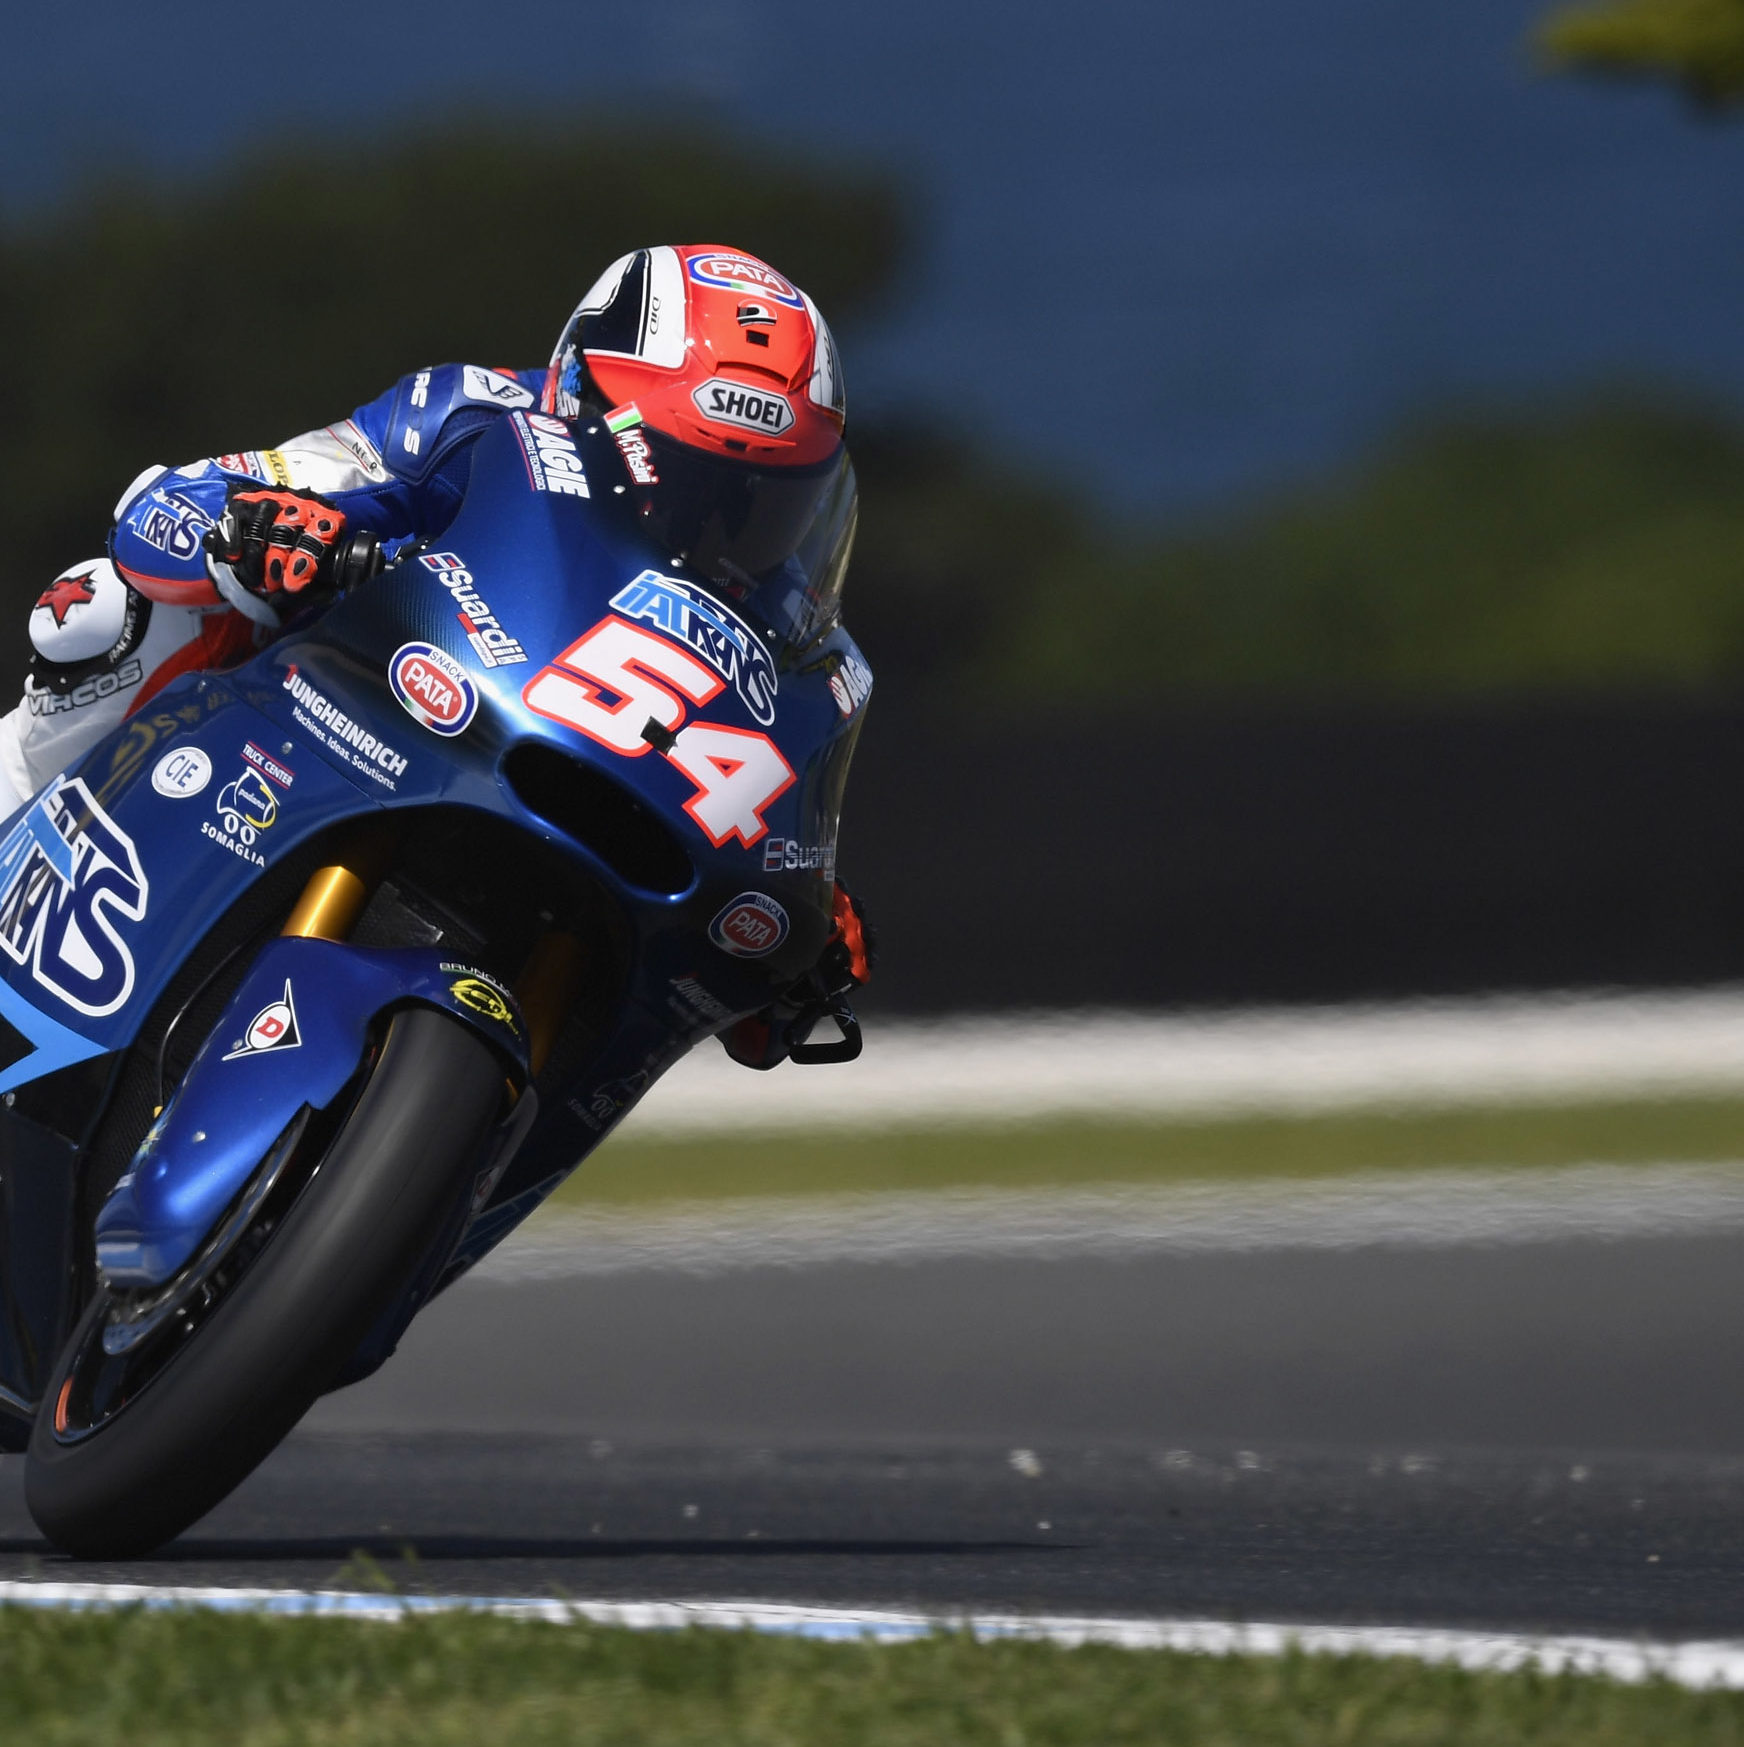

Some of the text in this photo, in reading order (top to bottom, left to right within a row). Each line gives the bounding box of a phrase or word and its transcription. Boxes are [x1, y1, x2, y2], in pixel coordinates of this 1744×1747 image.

[710, 261, 785, 291] PATA
[709, 388, 784, 428] SHOEI
[429, 651, 464, 682] SNACK
[405, 661, 454, 716] PATA
[283, 674, 408, 777] JUNGHEINRICH
[522, 614, 797, 849] 54
[242, 744, 294, 787] TRUCK CENTER
[292, 706, 396, 791] Machines. Ideas. Solutions.
[200, 821, 266, 868] SOMAGLIA
[728, 911, 771, 945] PATA
[256, 1016, 284, 1038] D
